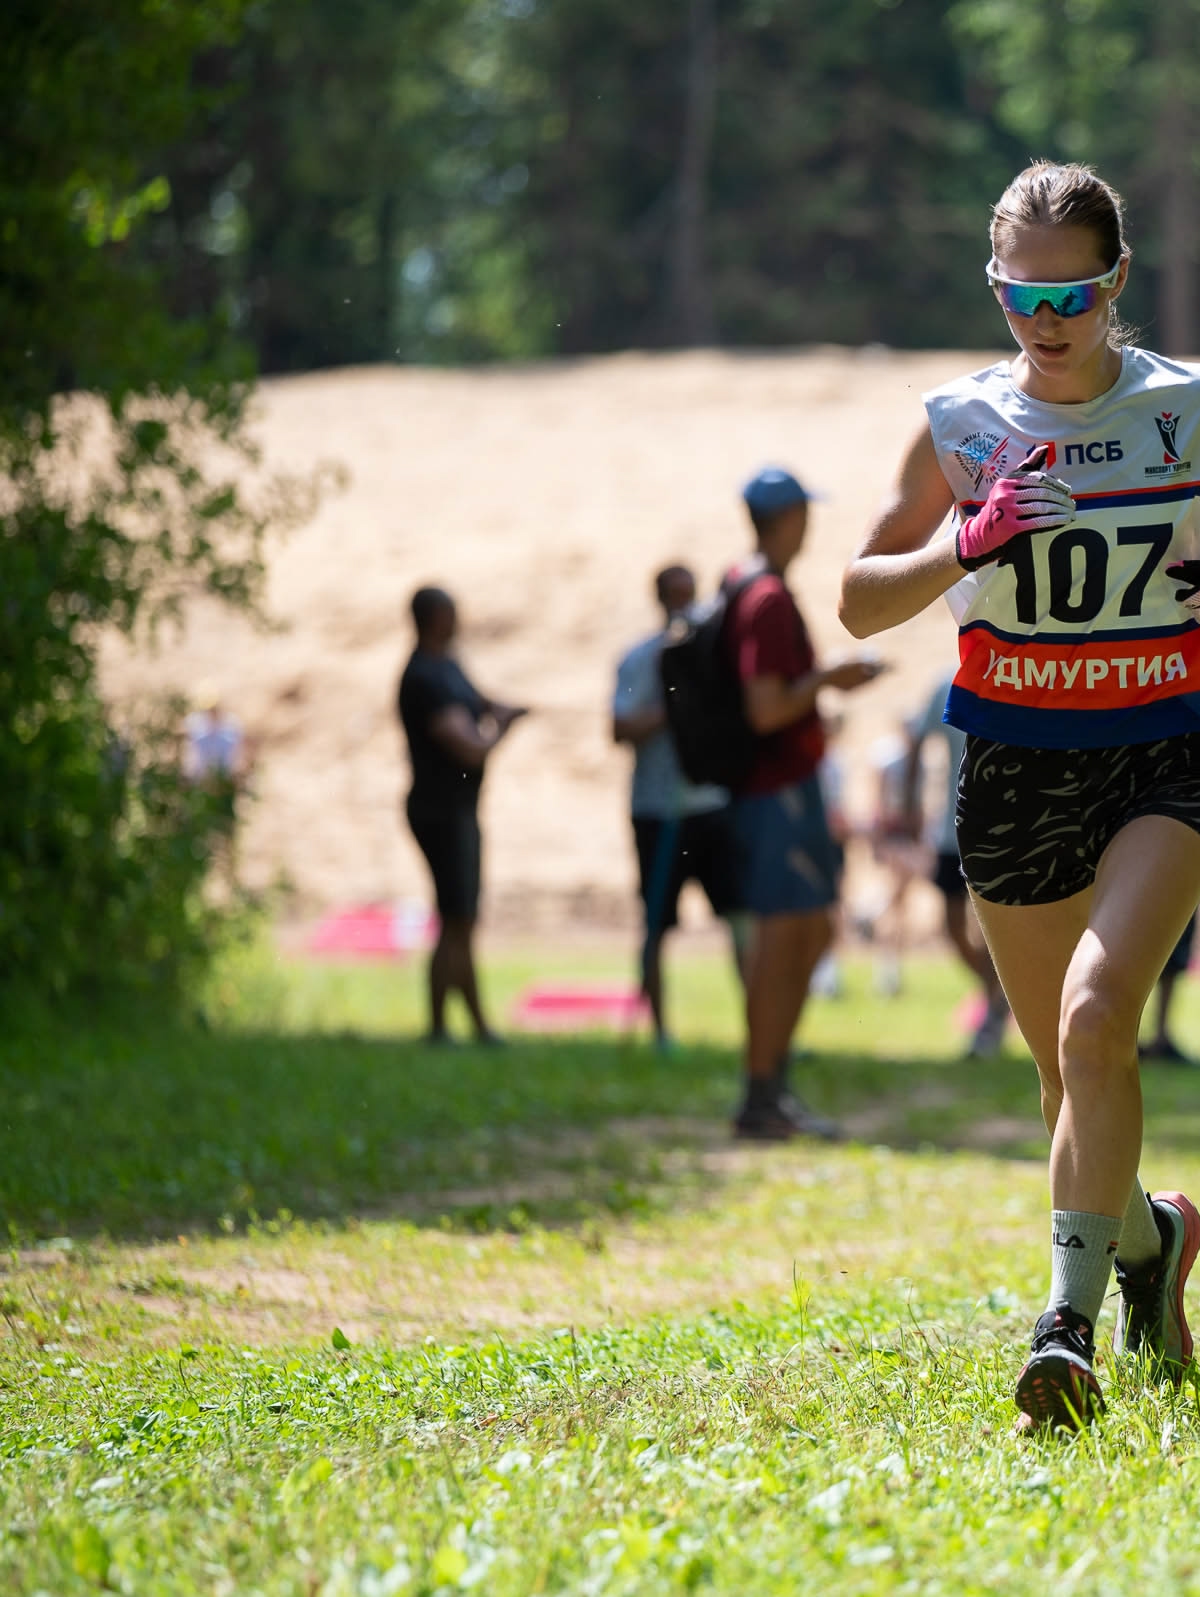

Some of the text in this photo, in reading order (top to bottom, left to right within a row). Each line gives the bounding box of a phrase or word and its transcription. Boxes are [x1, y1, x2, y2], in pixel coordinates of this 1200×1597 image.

[1064, 440, 1124, 466] ПСБ
[997, 522, 1174, 625] 107
[982, 648, 1188, 691] УДМУРТИЯ
